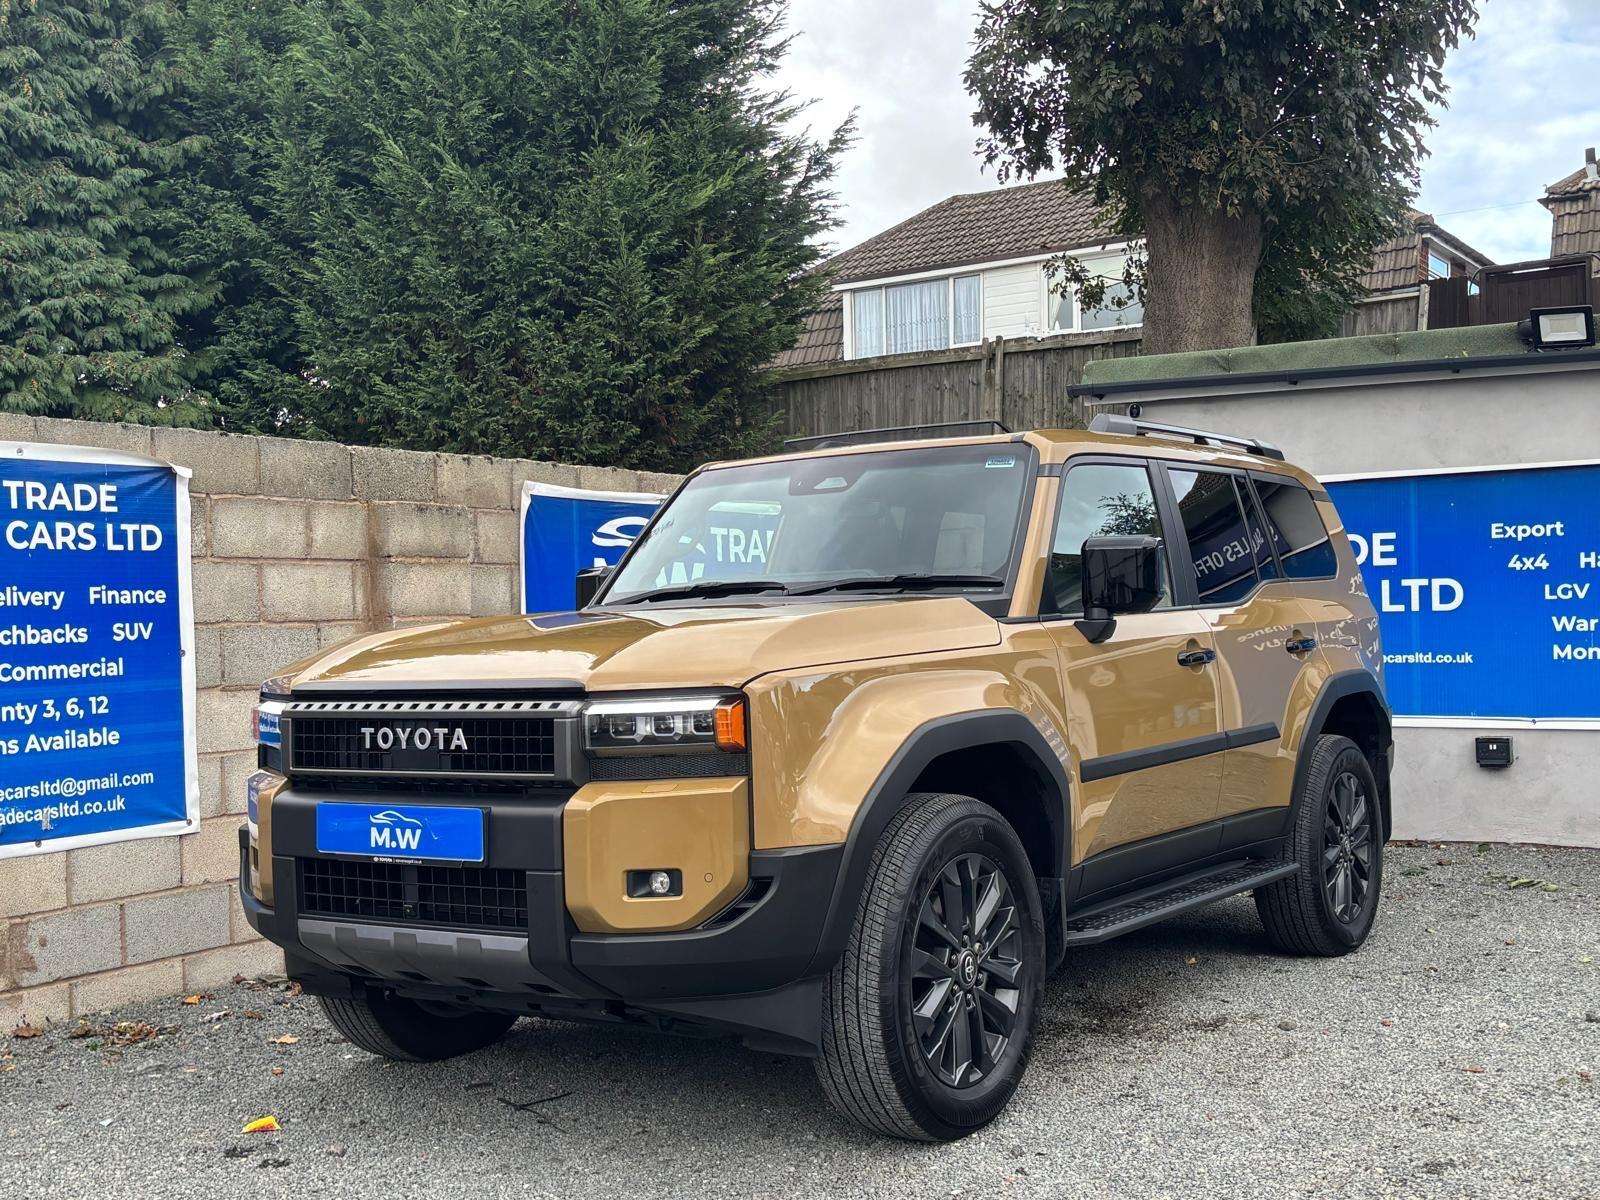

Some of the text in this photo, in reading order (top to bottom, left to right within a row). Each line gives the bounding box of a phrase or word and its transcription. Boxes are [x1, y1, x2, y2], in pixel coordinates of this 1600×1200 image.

[2, 479, 119, 513] TRADE
[5, 519, 163, 552] CARS LTD
[1491, 520, 1565, 542] Export
[710, 526, 775, 563] TRA
[1507, 553, 1550, 572] 4x4
[89, 584, 167, 605] Finance
[1381, 578, 1464, 613] LTD
[1544, 583, 1590, 601] LGV
[0, 622, 154, 646] chbacks SUV
[1551, 615, 1599, 633] War
[0, 657, 124, 683] Commercial
[1, 695, 109, 725] nty 3, 6, 12
[24, 727, 120, 753] Available
[361, 726, 468, 751] TOYOTA
[370, 826, 422, 850] M.W
